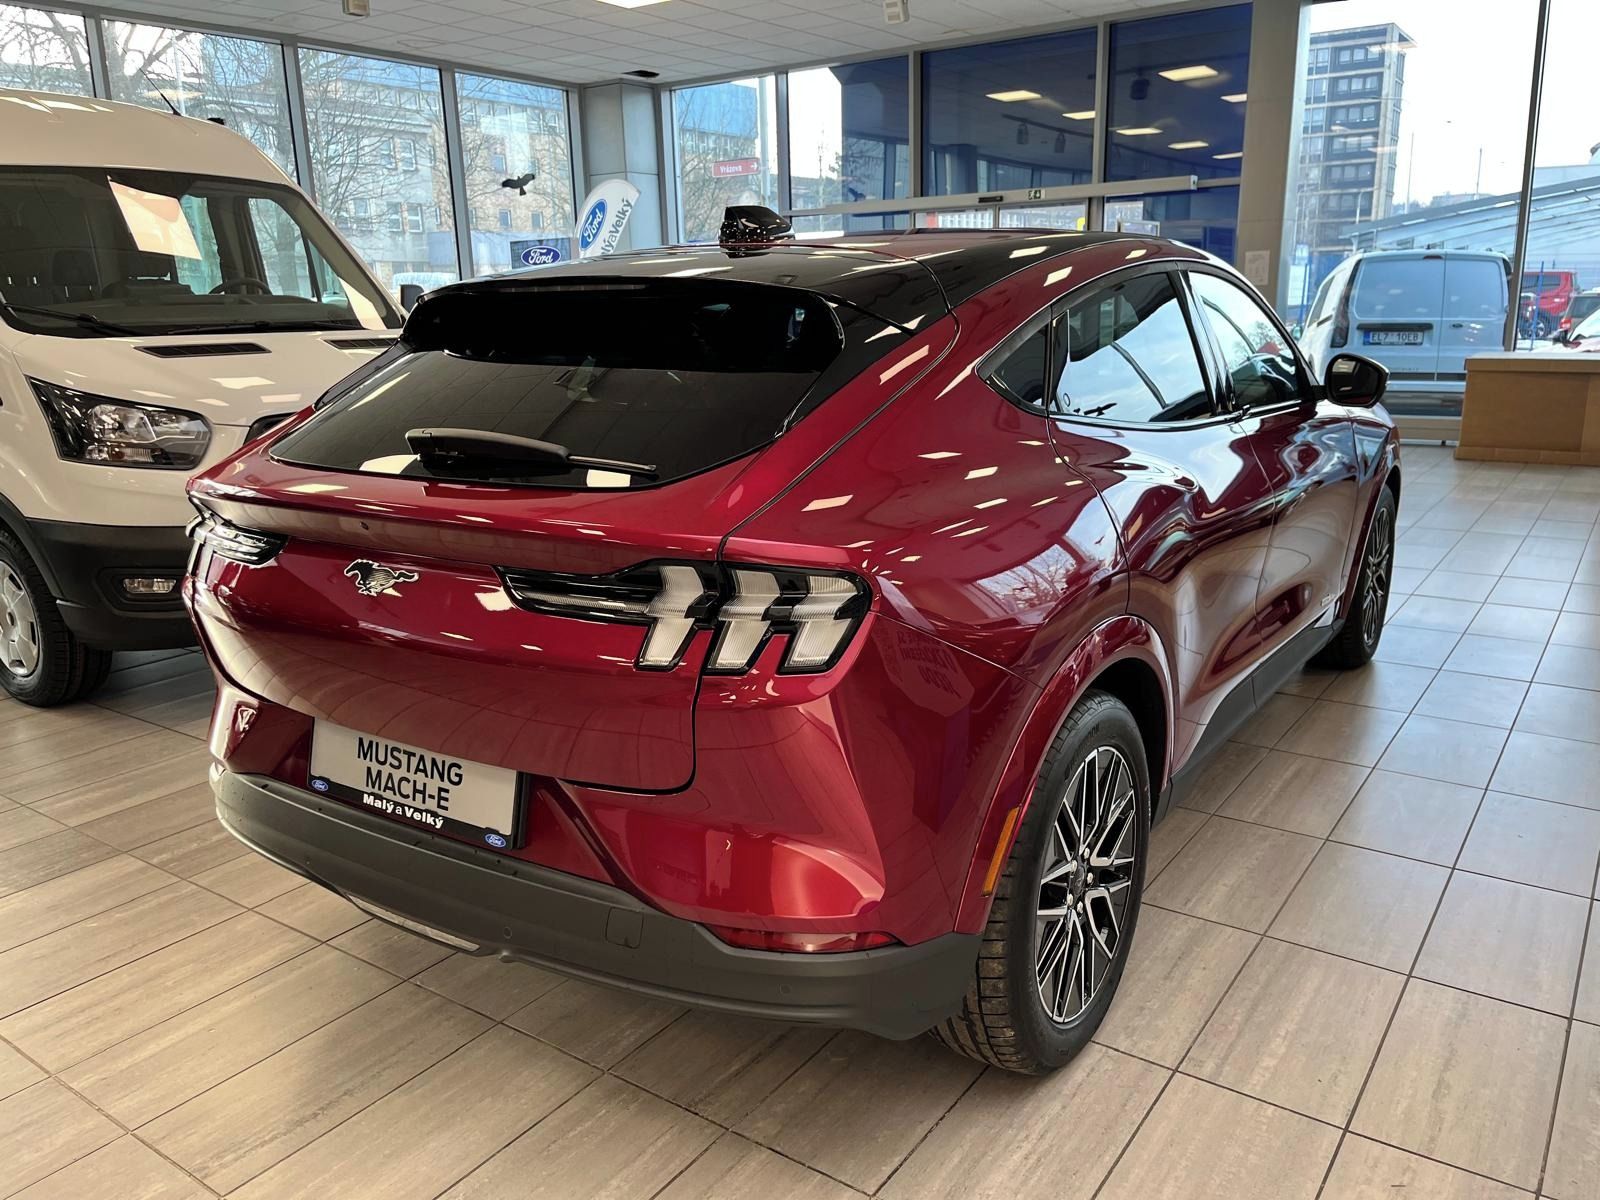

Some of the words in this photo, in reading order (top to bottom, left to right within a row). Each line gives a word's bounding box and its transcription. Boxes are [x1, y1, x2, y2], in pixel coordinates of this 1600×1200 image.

[582, 205, 604, 244] Ford
[526, 247, 555, 264] Ford
[357, 737, 463, 786] MUSTANG
[365, 767, 450, 811] MACH-E
[362, 793, 394, 813] Malý
[404, 806, 444, 829] Velký
